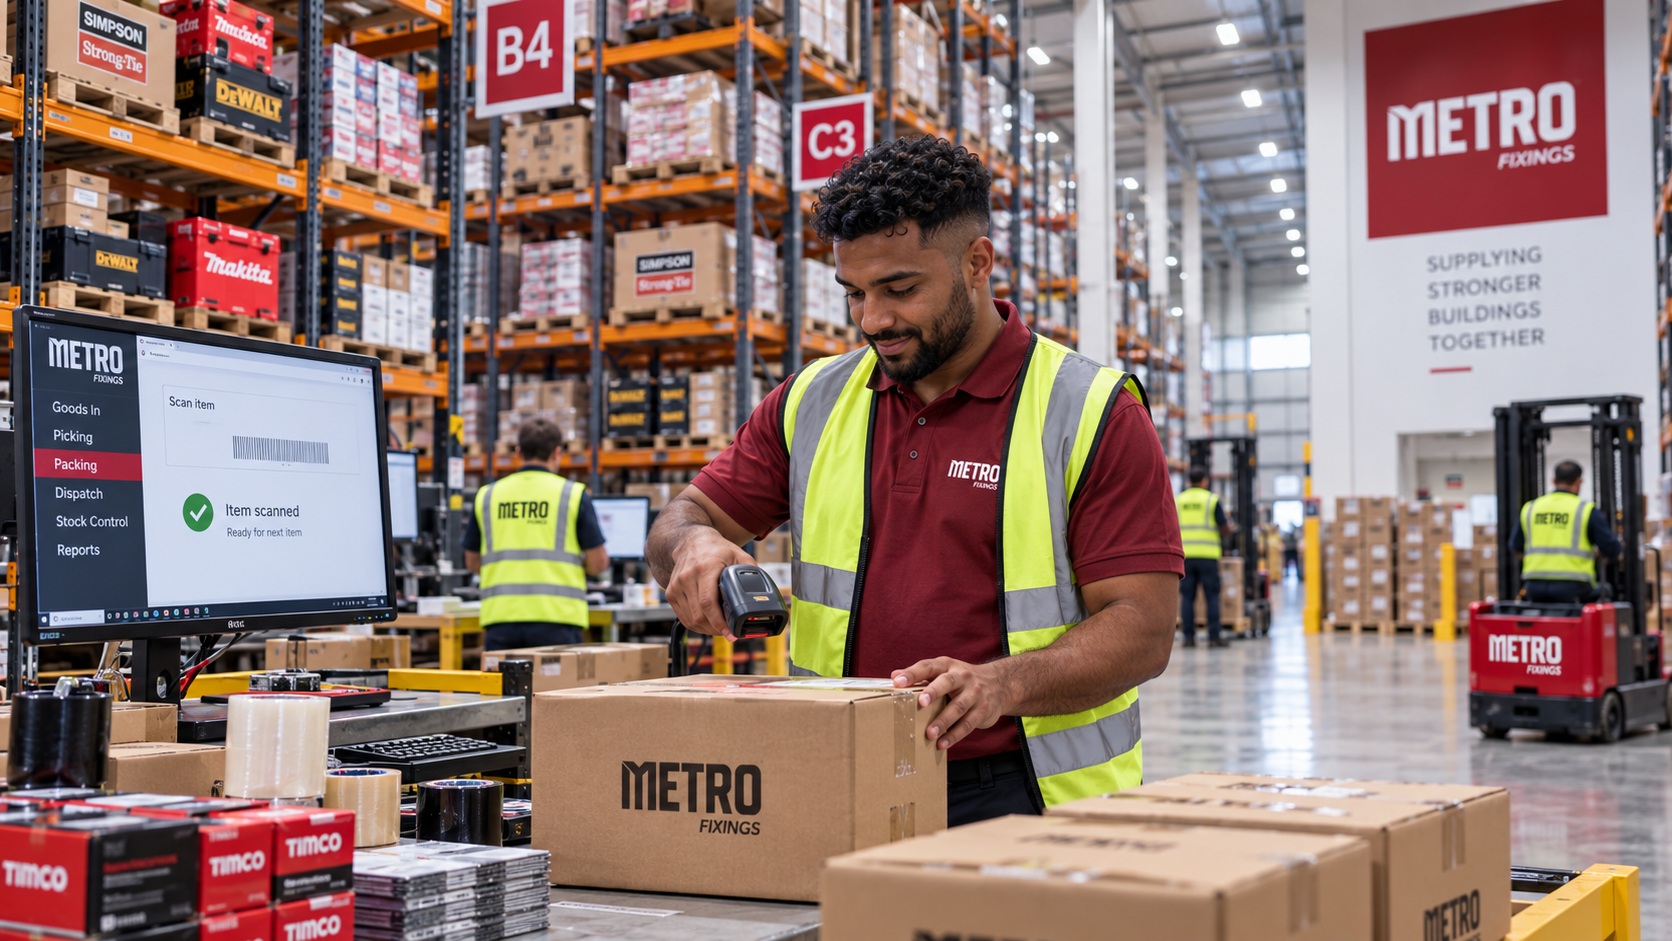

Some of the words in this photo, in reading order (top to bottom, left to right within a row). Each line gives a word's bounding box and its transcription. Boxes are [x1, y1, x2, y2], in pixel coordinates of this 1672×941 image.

[84, 11, 143, 44] SIMPSON
[497, 20, 553, 76] B4
[1387, 81, 1576, 162] METRO
[808, 119, 856, 160] C3
[1497, 144, 1576, 170] FIXINGS
[204, 251, 273, 285] Makita
[639, 255, 690, 271] SIMPSON
[1426, 245, 1542, 273] SUPPLYING
[1427, 273, 1541, 300] STRONGER
[1428, 300, 1541, 326] BUILDINGS
[1428, 327, 1544, 351] TOGETHER
[48, 337, 124, 374] METRO
[93, 374, 124, 385] FIXINGS
[52, 401, 88, 415] Goods
[90, 404, 101, 416] In
[169, 395, 193, 408] Scan
[194, 398, 215, 410] item
[53, 429, 93, 445] Picking
[54, 458, 97, 474] Packing
[947, 459, 1000, 483] METRO
[55, 486, 104, 501] Dispatch
[56, 515, 88, 527] Stock
[89, 515, 129, 527] Control
[225, 503, 252, 517] Item
[254, 505, 300, 517] scanned
[498, 501, 549, 519] METRO
[226, 527, 252, 539] Ready
[253, 526, 265, 537] for
[266, 527, 284, 537] next
[285, 527, 303, 537] item
[57, 544, 101, 559] Reports
[1488, 633, 1563, 664] METRO
[622, 761, 762, 815] METRO
[699, 819, 761, 836] FIXINGS
[286, 832, 342, 858] TIMCO
[2, 860, 68, 892] TIMCO
[209, 851, 265, 877] TIMCO
[1424, 888, 1480, 941] METRO
[284, 915, 341, 941] TIMCO
